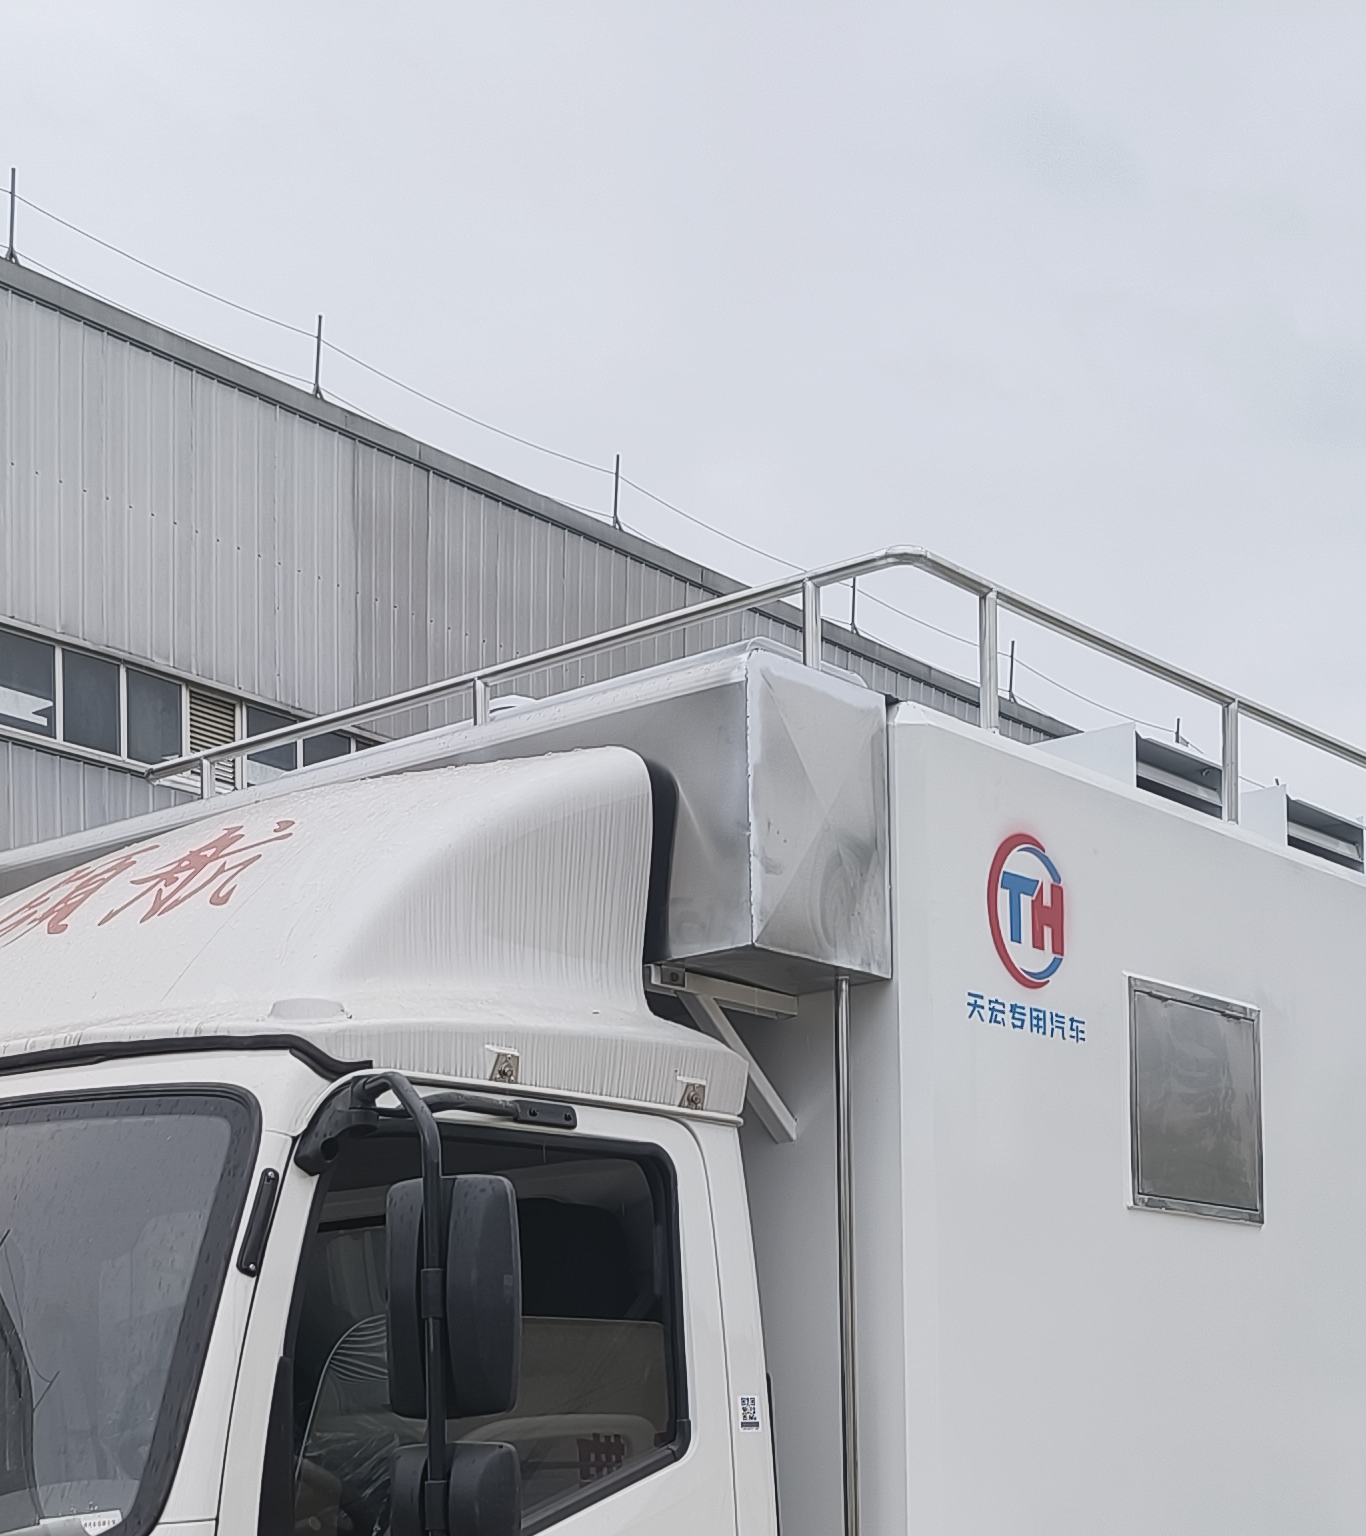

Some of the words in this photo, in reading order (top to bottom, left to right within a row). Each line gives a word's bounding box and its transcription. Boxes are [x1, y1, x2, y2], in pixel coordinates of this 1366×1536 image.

[1000, 870, 1065, 957] TH
[966, 991, 1086, 1043] 天宏专用汽车
